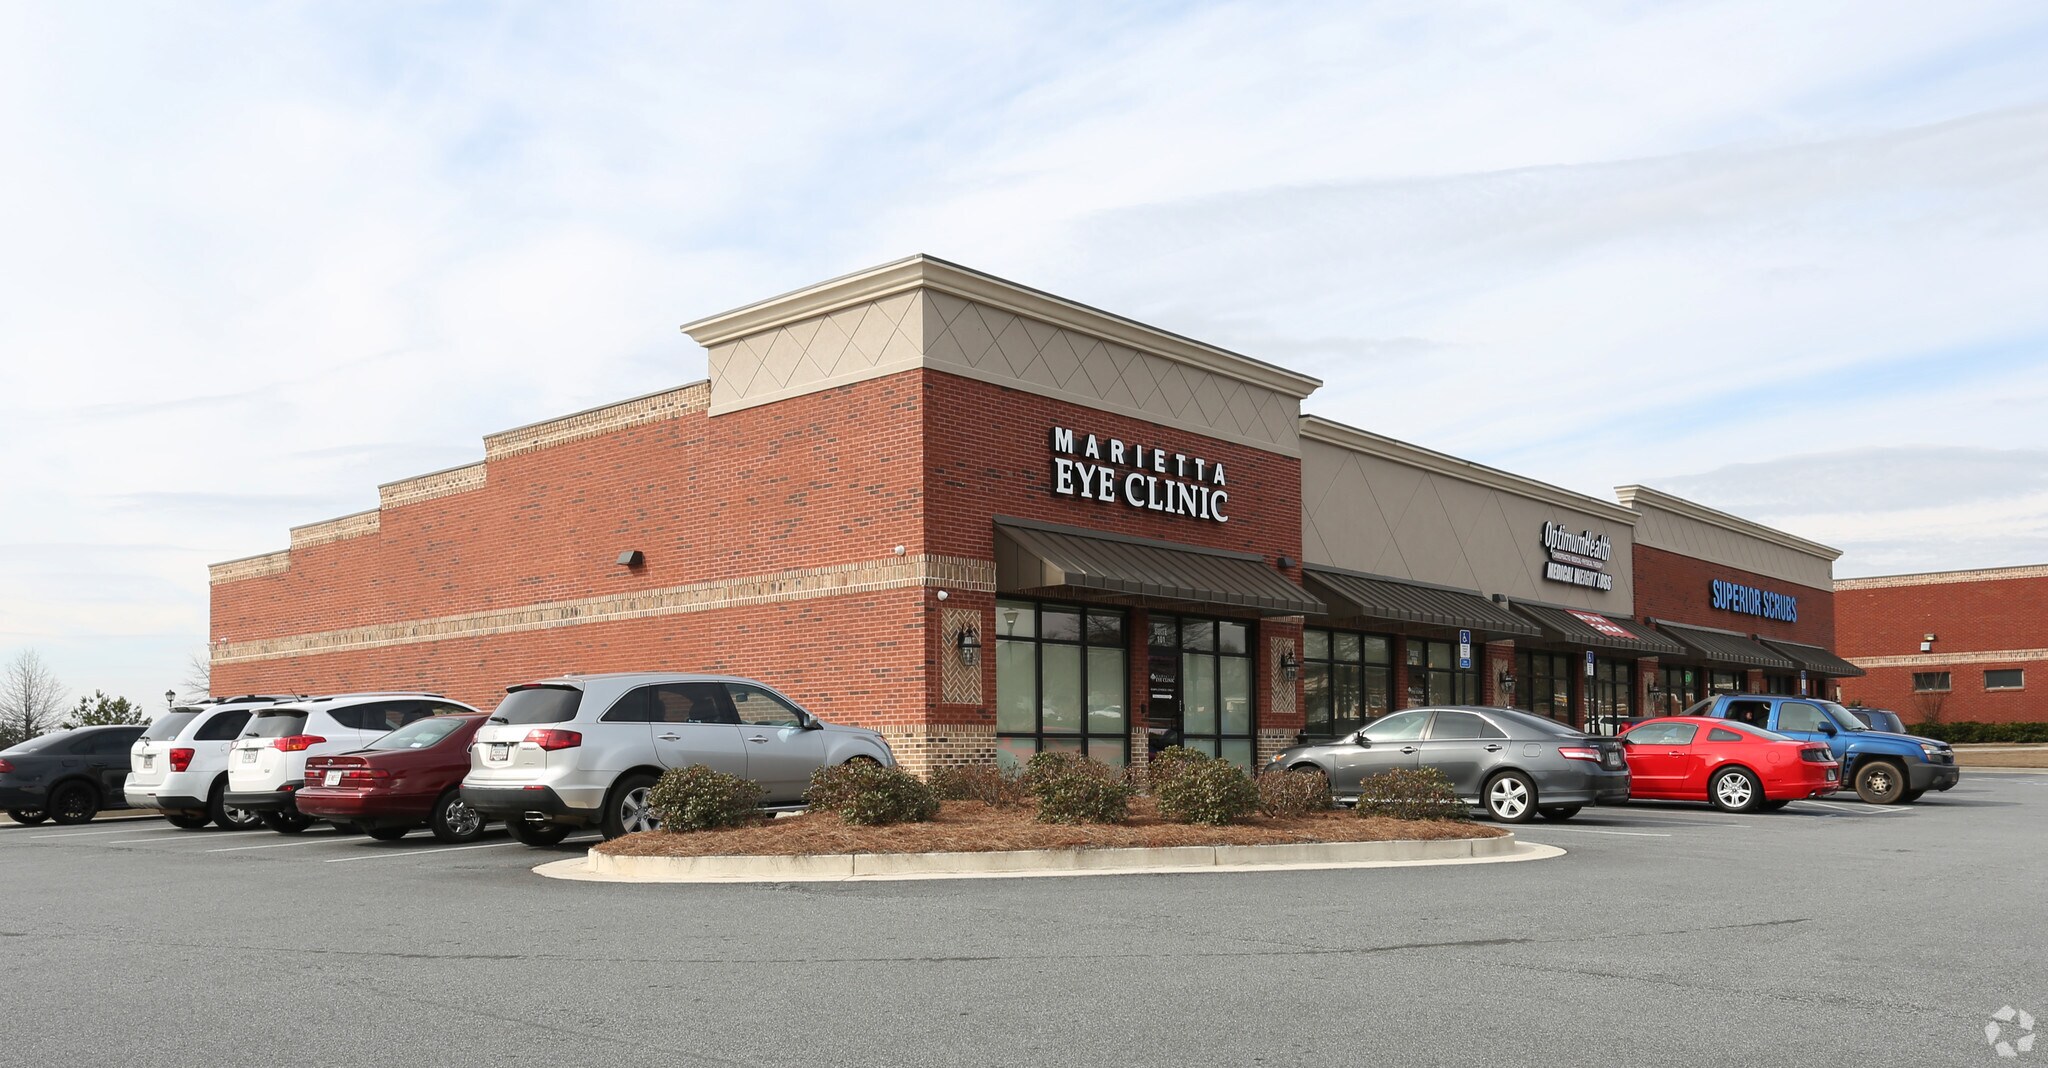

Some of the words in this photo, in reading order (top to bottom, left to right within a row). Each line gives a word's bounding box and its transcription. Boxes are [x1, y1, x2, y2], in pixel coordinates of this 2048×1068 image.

[1054, 426, 1226, 486] MARIETTA
[1054, 457, 1116, 502] EYE
[1124, 472, 1229, 523] CLINIC
[1546, 561, 1574, 583] MEDICAL
[1574, 567, 1598, 587] WEIGHT
[1597, 572, 1612, 591] LOSS
[1712, 579, 1762, 616] SUPERIOR
[1763, 590, 1798, 623] SCRUBS
